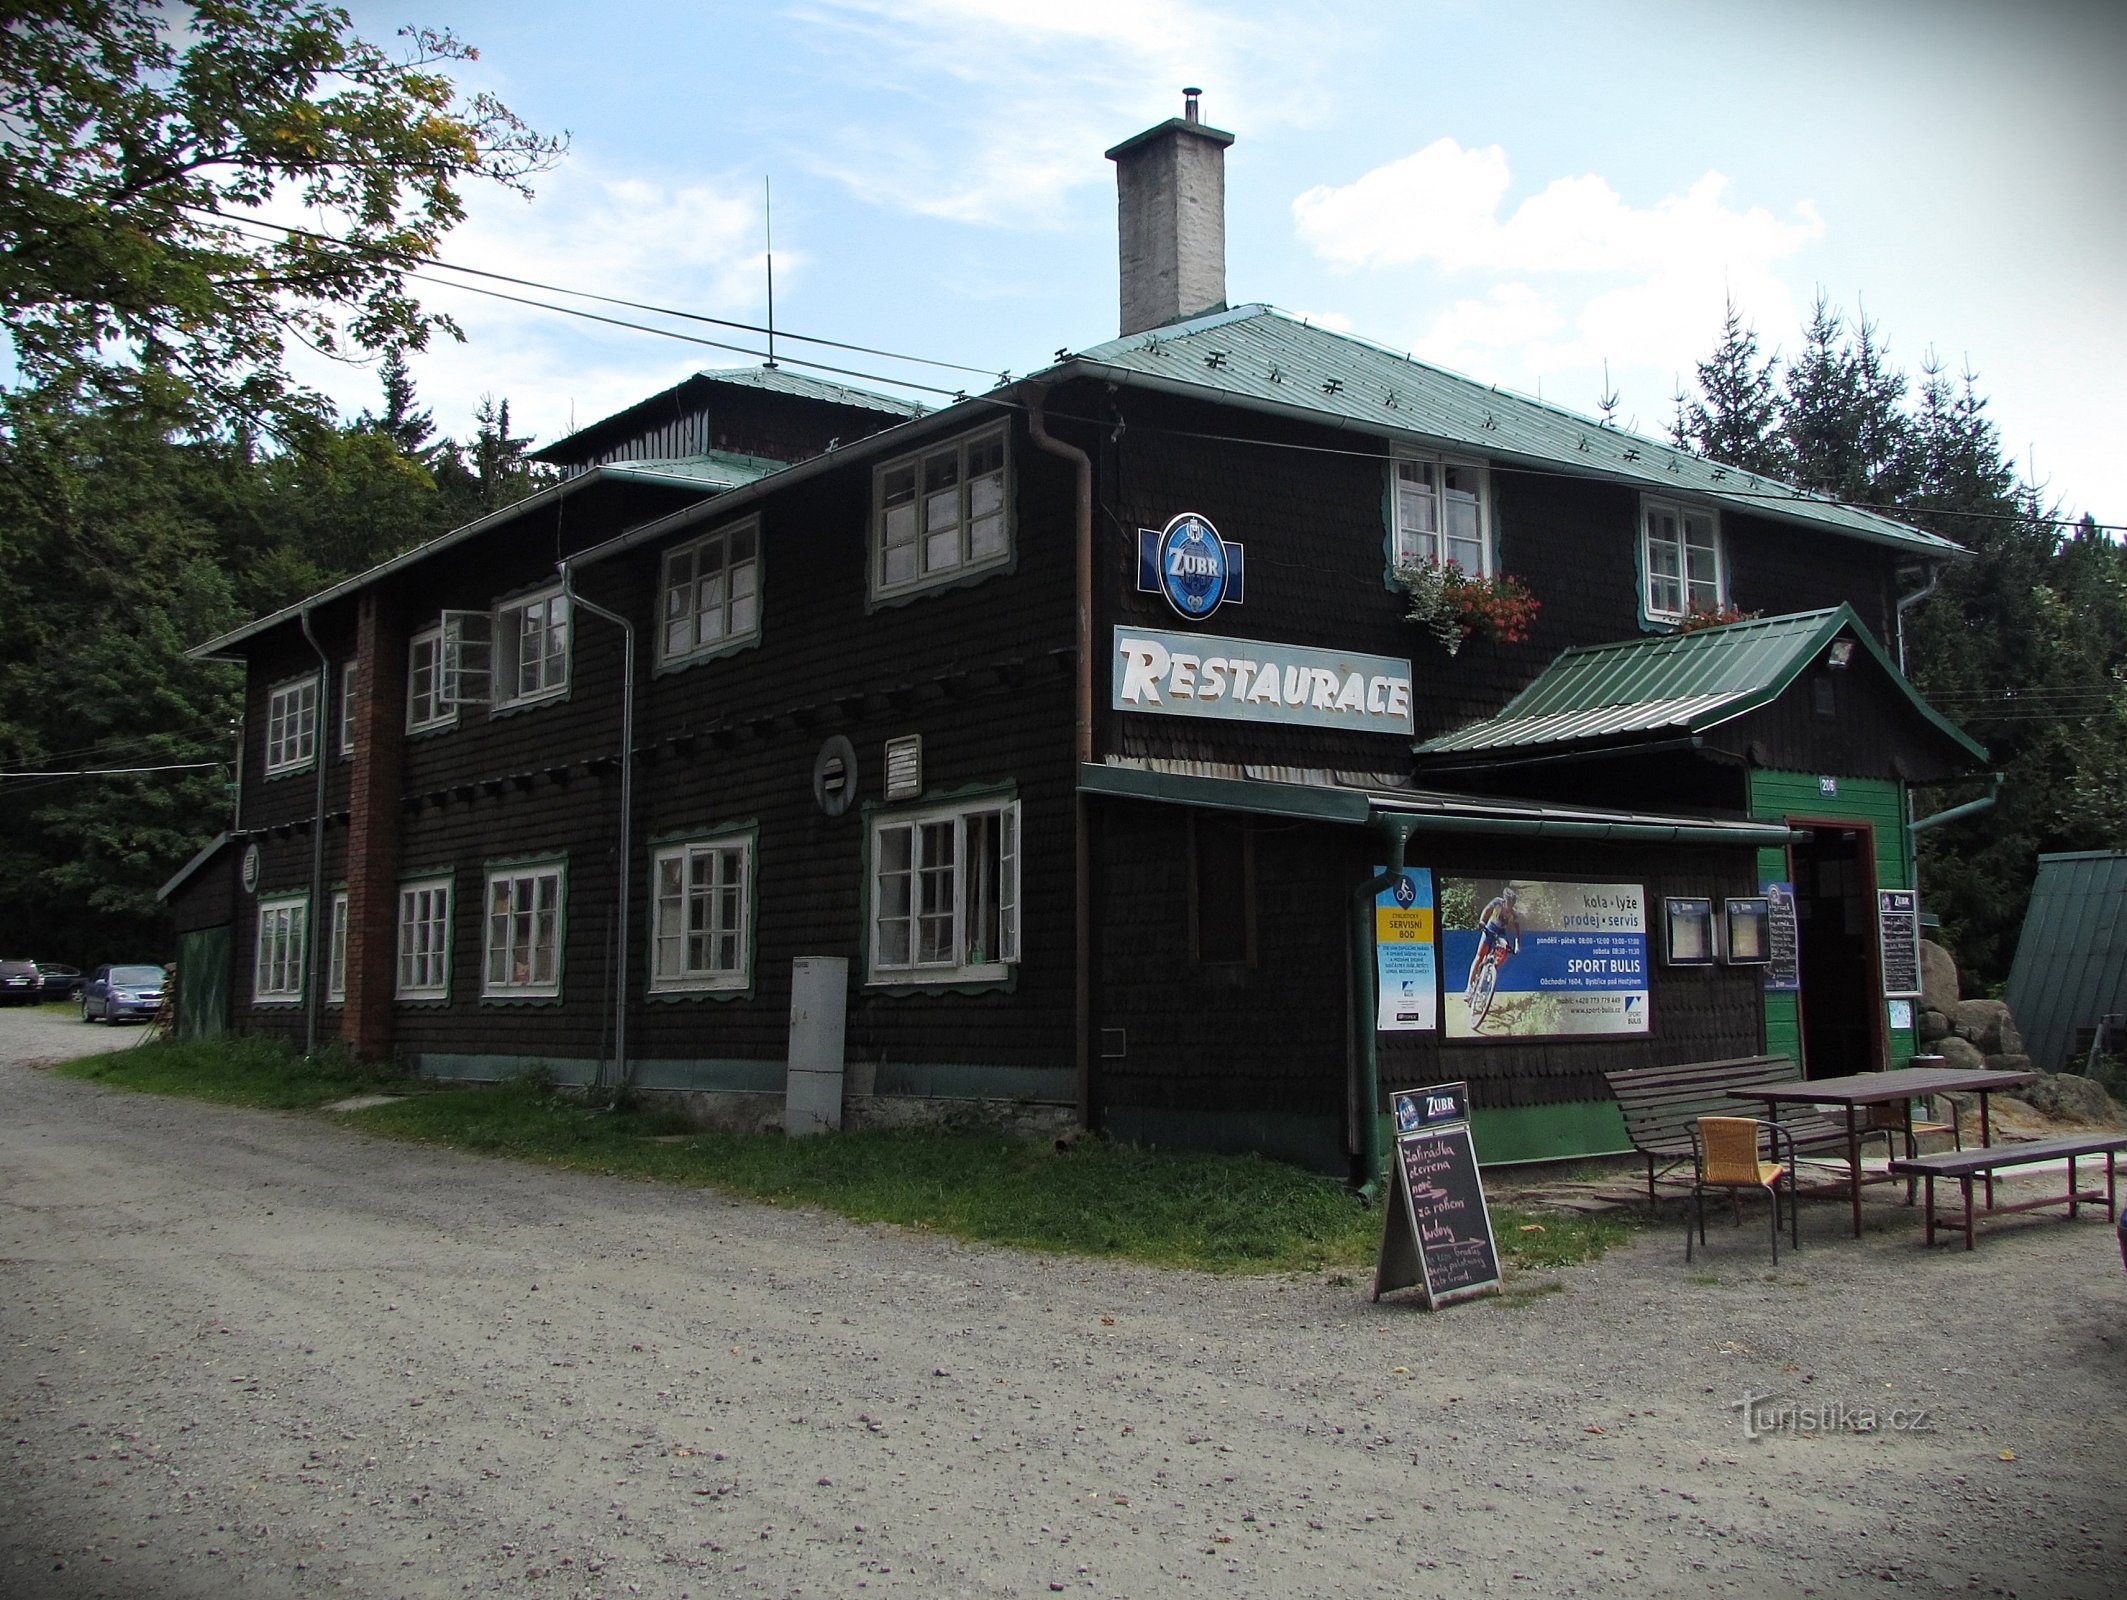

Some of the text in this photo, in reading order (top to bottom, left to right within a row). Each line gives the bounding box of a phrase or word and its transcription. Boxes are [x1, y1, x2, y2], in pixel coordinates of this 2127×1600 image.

[1169, 547, 1220, 577] ZUBR
[1119, 638, 1410, 720] RESTAURACE
[1821, 779, 1835, 791] 206
[1583, 895, 1638, 911] kola lyže
[1389, 919, 1423, 929] SERVISNÍ
[1563, 913, 1639, 928] prodej servis
[1400, 930, 1415, 939] BOD
[1568, 959, 1641, 973] SPORT BULIS
[1426, 1096, 1456, 1117] ZUBR
[1433, 1197, 1465, 1214] rohem
[1421, 1219, 1456, 1244] budovy
